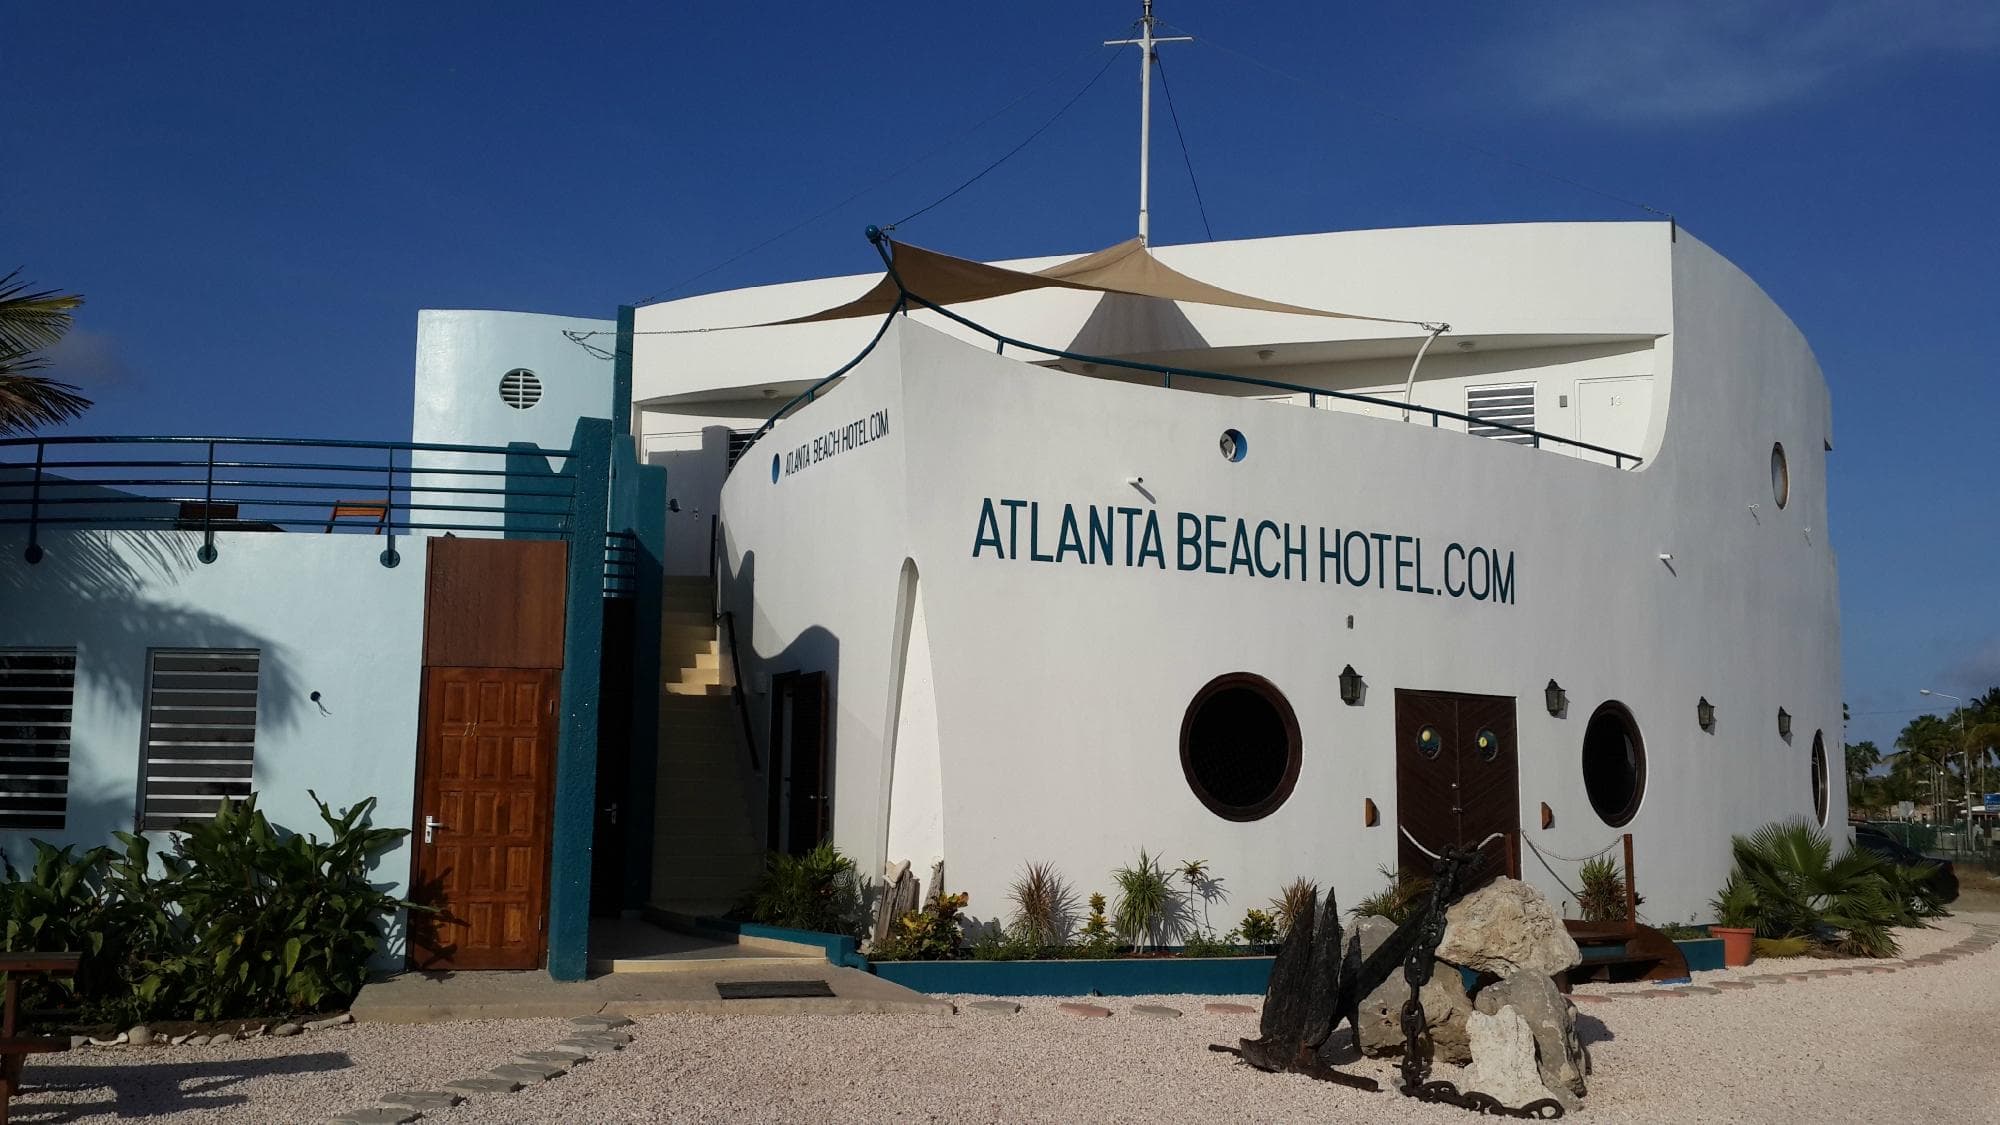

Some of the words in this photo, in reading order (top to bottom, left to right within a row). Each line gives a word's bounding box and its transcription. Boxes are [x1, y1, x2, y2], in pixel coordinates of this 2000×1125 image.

[785, 443, 810, 477] ATLANTA
[813, 429, 841, 464] BEACH
[842, 408, 889, 453] HOTEL.COM
[972, 497, 1166, 570] ATLANTA
[1177, 512, 1307, 582] BEACH
[1319, 526, 1515, 605] HOTEL.COM
